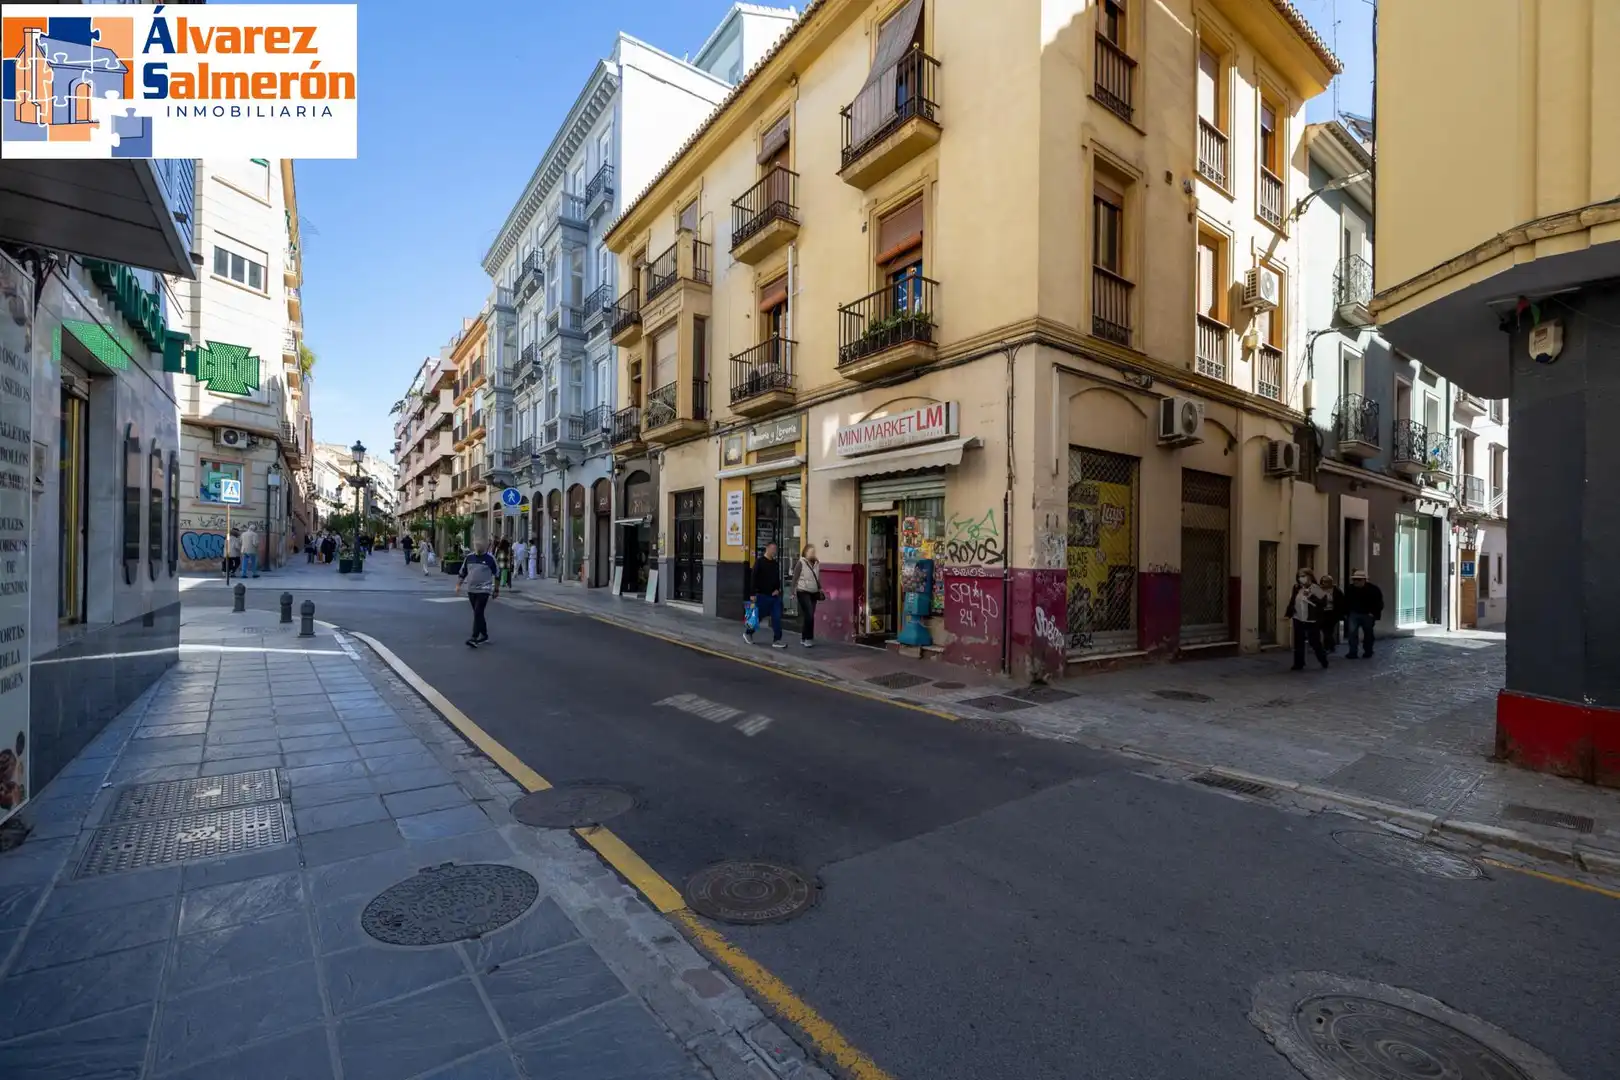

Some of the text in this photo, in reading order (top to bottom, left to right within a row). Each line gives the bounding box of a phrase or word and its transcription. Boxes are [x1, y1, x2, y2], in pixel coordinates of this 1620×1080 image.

[838, 428, 862, 447] MINI
[864, 415, 915, 442] MARKET
[916, 404, 944, 432] LM
[0, 539, 28, 552] ORISCOS
[0, 624, 25, 643] ORTAS
[0, 673, 23, 694] IRGEN
